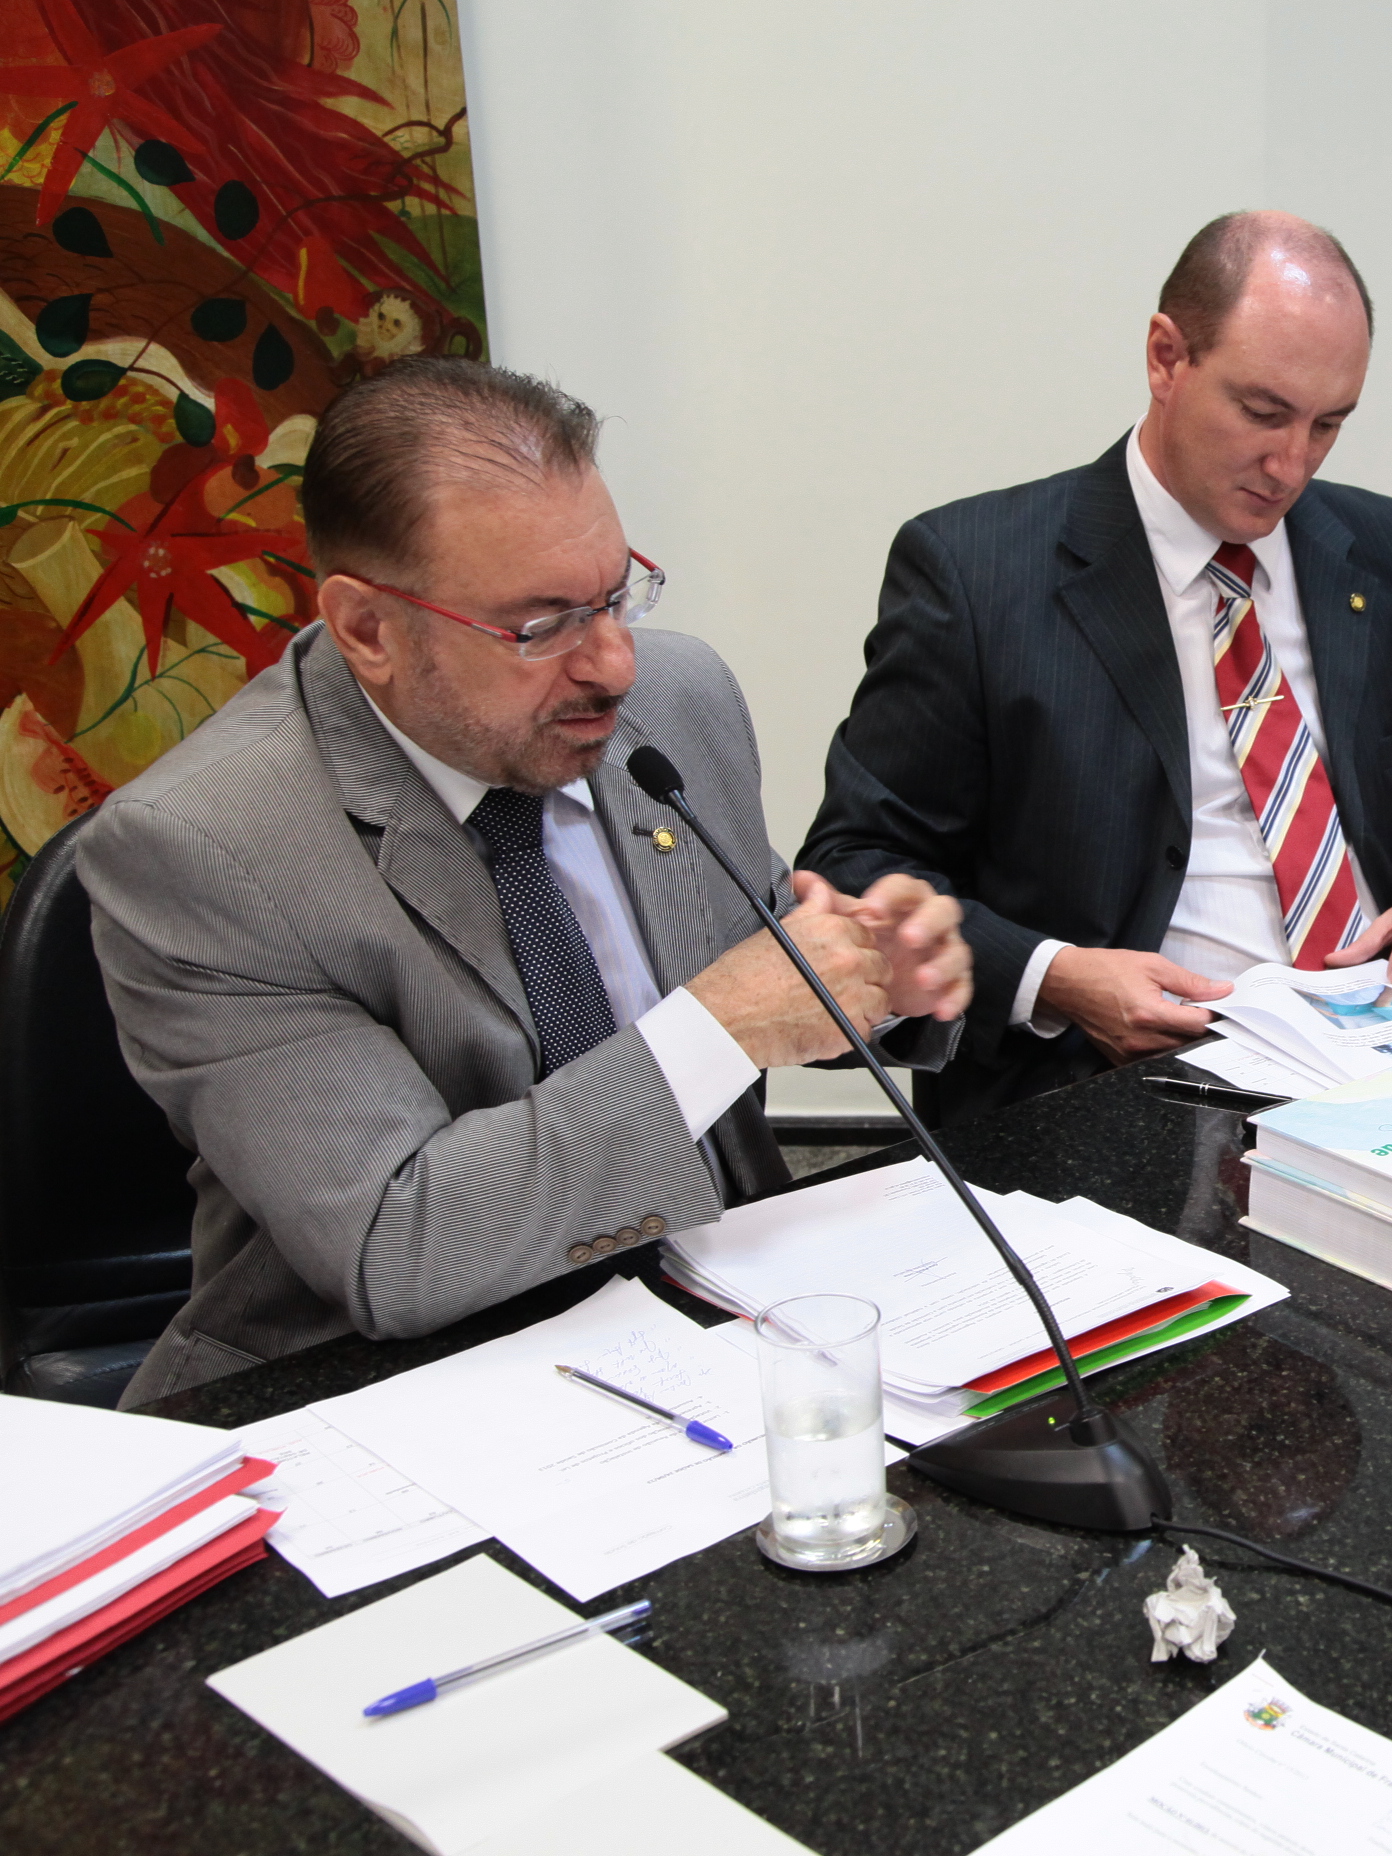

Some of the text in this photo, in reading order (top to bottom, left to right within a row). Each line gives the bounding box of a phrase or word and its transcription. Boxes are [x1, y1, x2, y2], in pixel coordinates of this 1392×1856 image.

[1291, 1730, 1323, 1750] Câmara
[1324, 1747, 1367, 1772] Municipal
[1366, 1770, 1378, 1779] de
